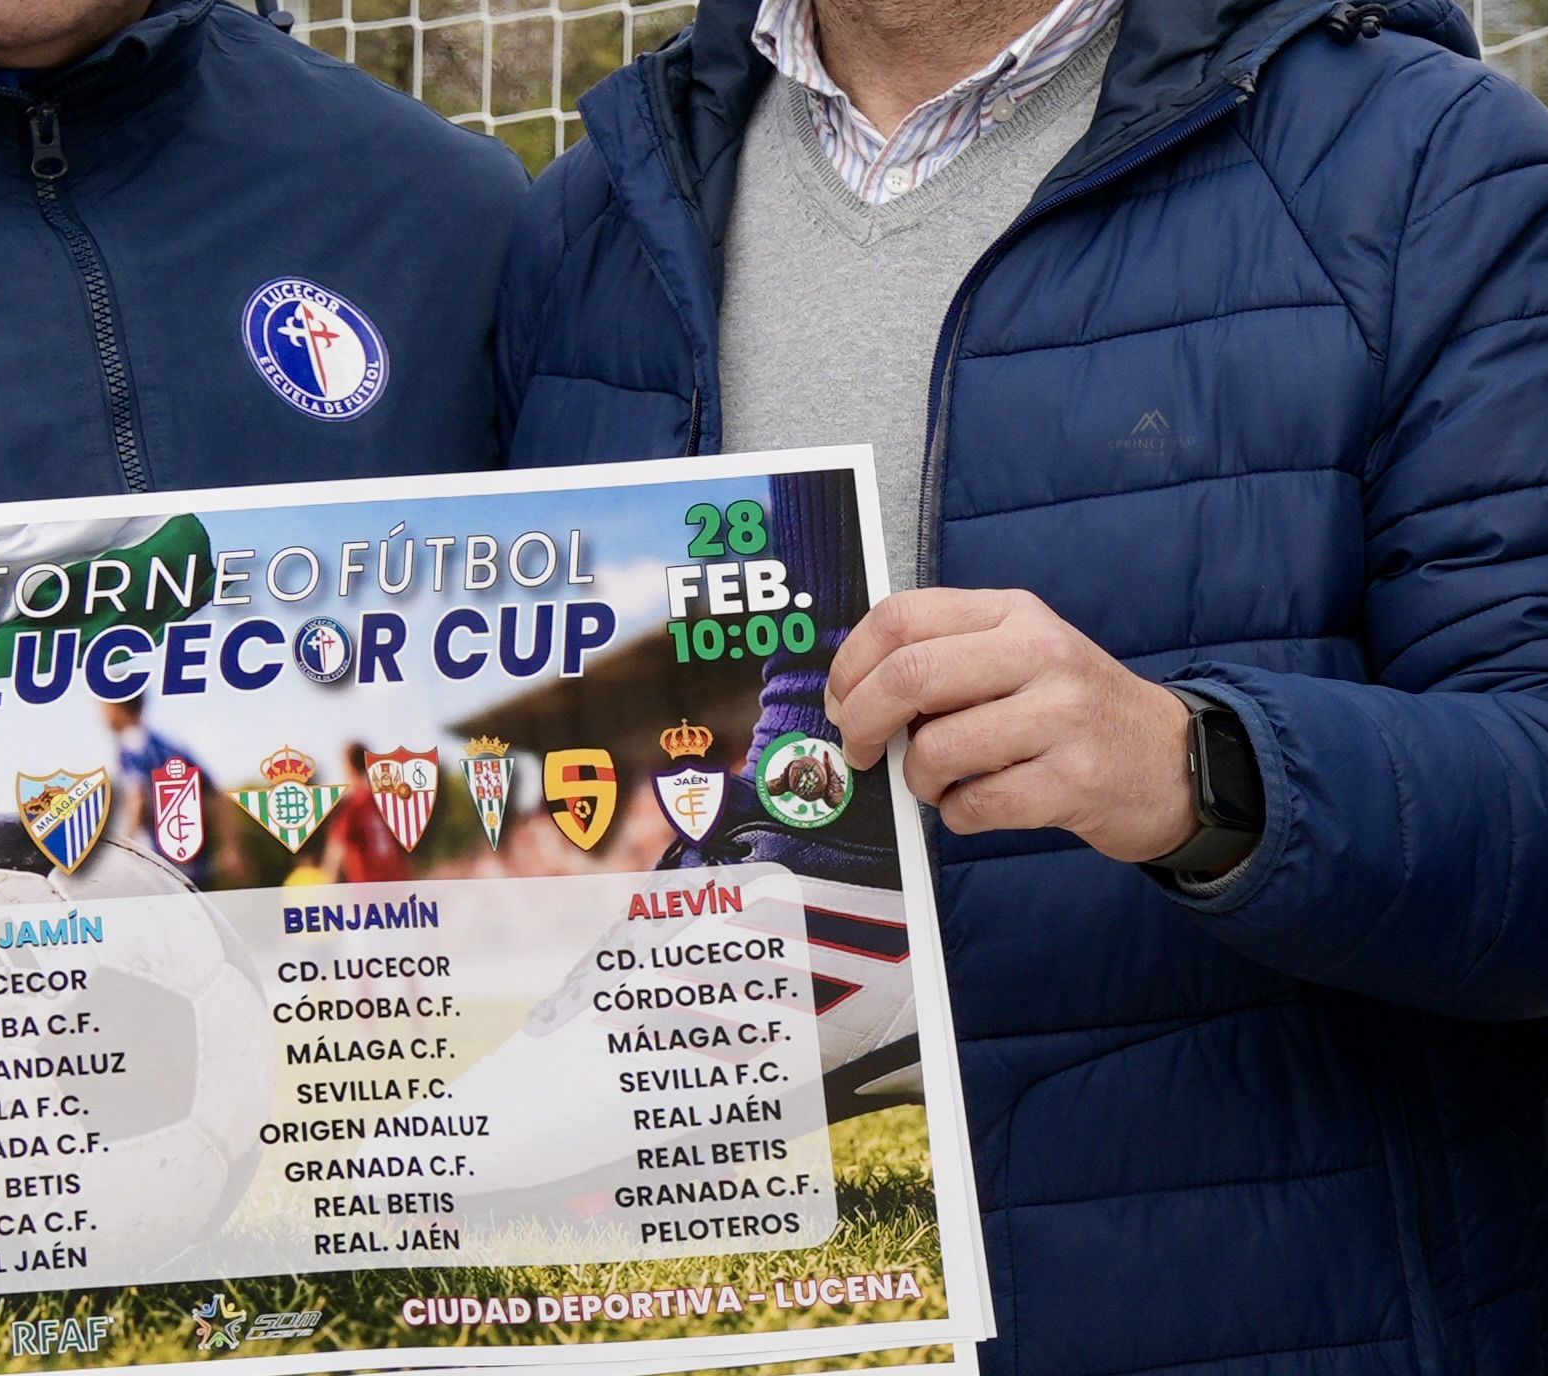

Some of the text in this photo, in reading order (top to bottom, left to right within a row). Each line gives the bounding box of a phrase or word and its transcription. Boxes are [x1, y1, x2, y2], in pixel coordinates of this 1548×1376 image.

[262, 284, 340, 314] LUCECOR
[259, 356, 379, 414] ESCUELA DE FUTBOL
[685, 500, 767, 559] 28
[339, 521, 595, 597] FÚTBOL
[666, 559, 812, 617] FEB.
[434, 599, 616, 680] CUP
[667, 615, 816, 663] 10:00
[673, 776, 708, 786] JAÉN
[284, 894, 439, 934] BENJAMÍN
[628, 880, 743, 920] ALEVÍN
[278, 956, 450, 983] CD. LUCECOR
[596, 938, 784, 972] CD. LUCECOR
[273, 995, 460, 1023] CÓRDOBA C.F.
[593, 978, 798, 1012] CÓRDOBA C.F.
[47, 1013, 100, 1036] C.F.
[608, 1022, 791, 1054] MÁLAGA C.F.
[287, 1036, 455, 1065] MÁLAGA C.F.
[297, 1079, 452, 1104] SEVILLA F.C.
[620, 1062, 788, 1093] SEVILLA F.C.
[37, 1096, 89, 1118] F.C.
[634, 1095, 781, 1130] REAL JAÉN
[57, 1133, 109, 1155] C.F.
[260, 1116, 489, 1145] ORIGEN ANDALUZ
[285, 1156, 474, 1182] GRANADA C.F.
[637, 1139, 788, 1170] REAL BETIS
[6, 1173, 80, 1197] BETIS
[615, 1174, 819, 1208] GRANADA C.F.
[314, 1192, 454, 1218] REAL BETIS
[44, 1210, 97, 1232] C.F.
[641, 1212, 800, 1244] PELOTEROS
[314, 1223, 459, 1255] REAL. JAÉN
[14, 1242, 88, 1272] JAÉN
[402, 1272, 922, 1325] CIUDAD DEPORTIVA LUCENA
[12, 1316, 110, 1355] RFAF
